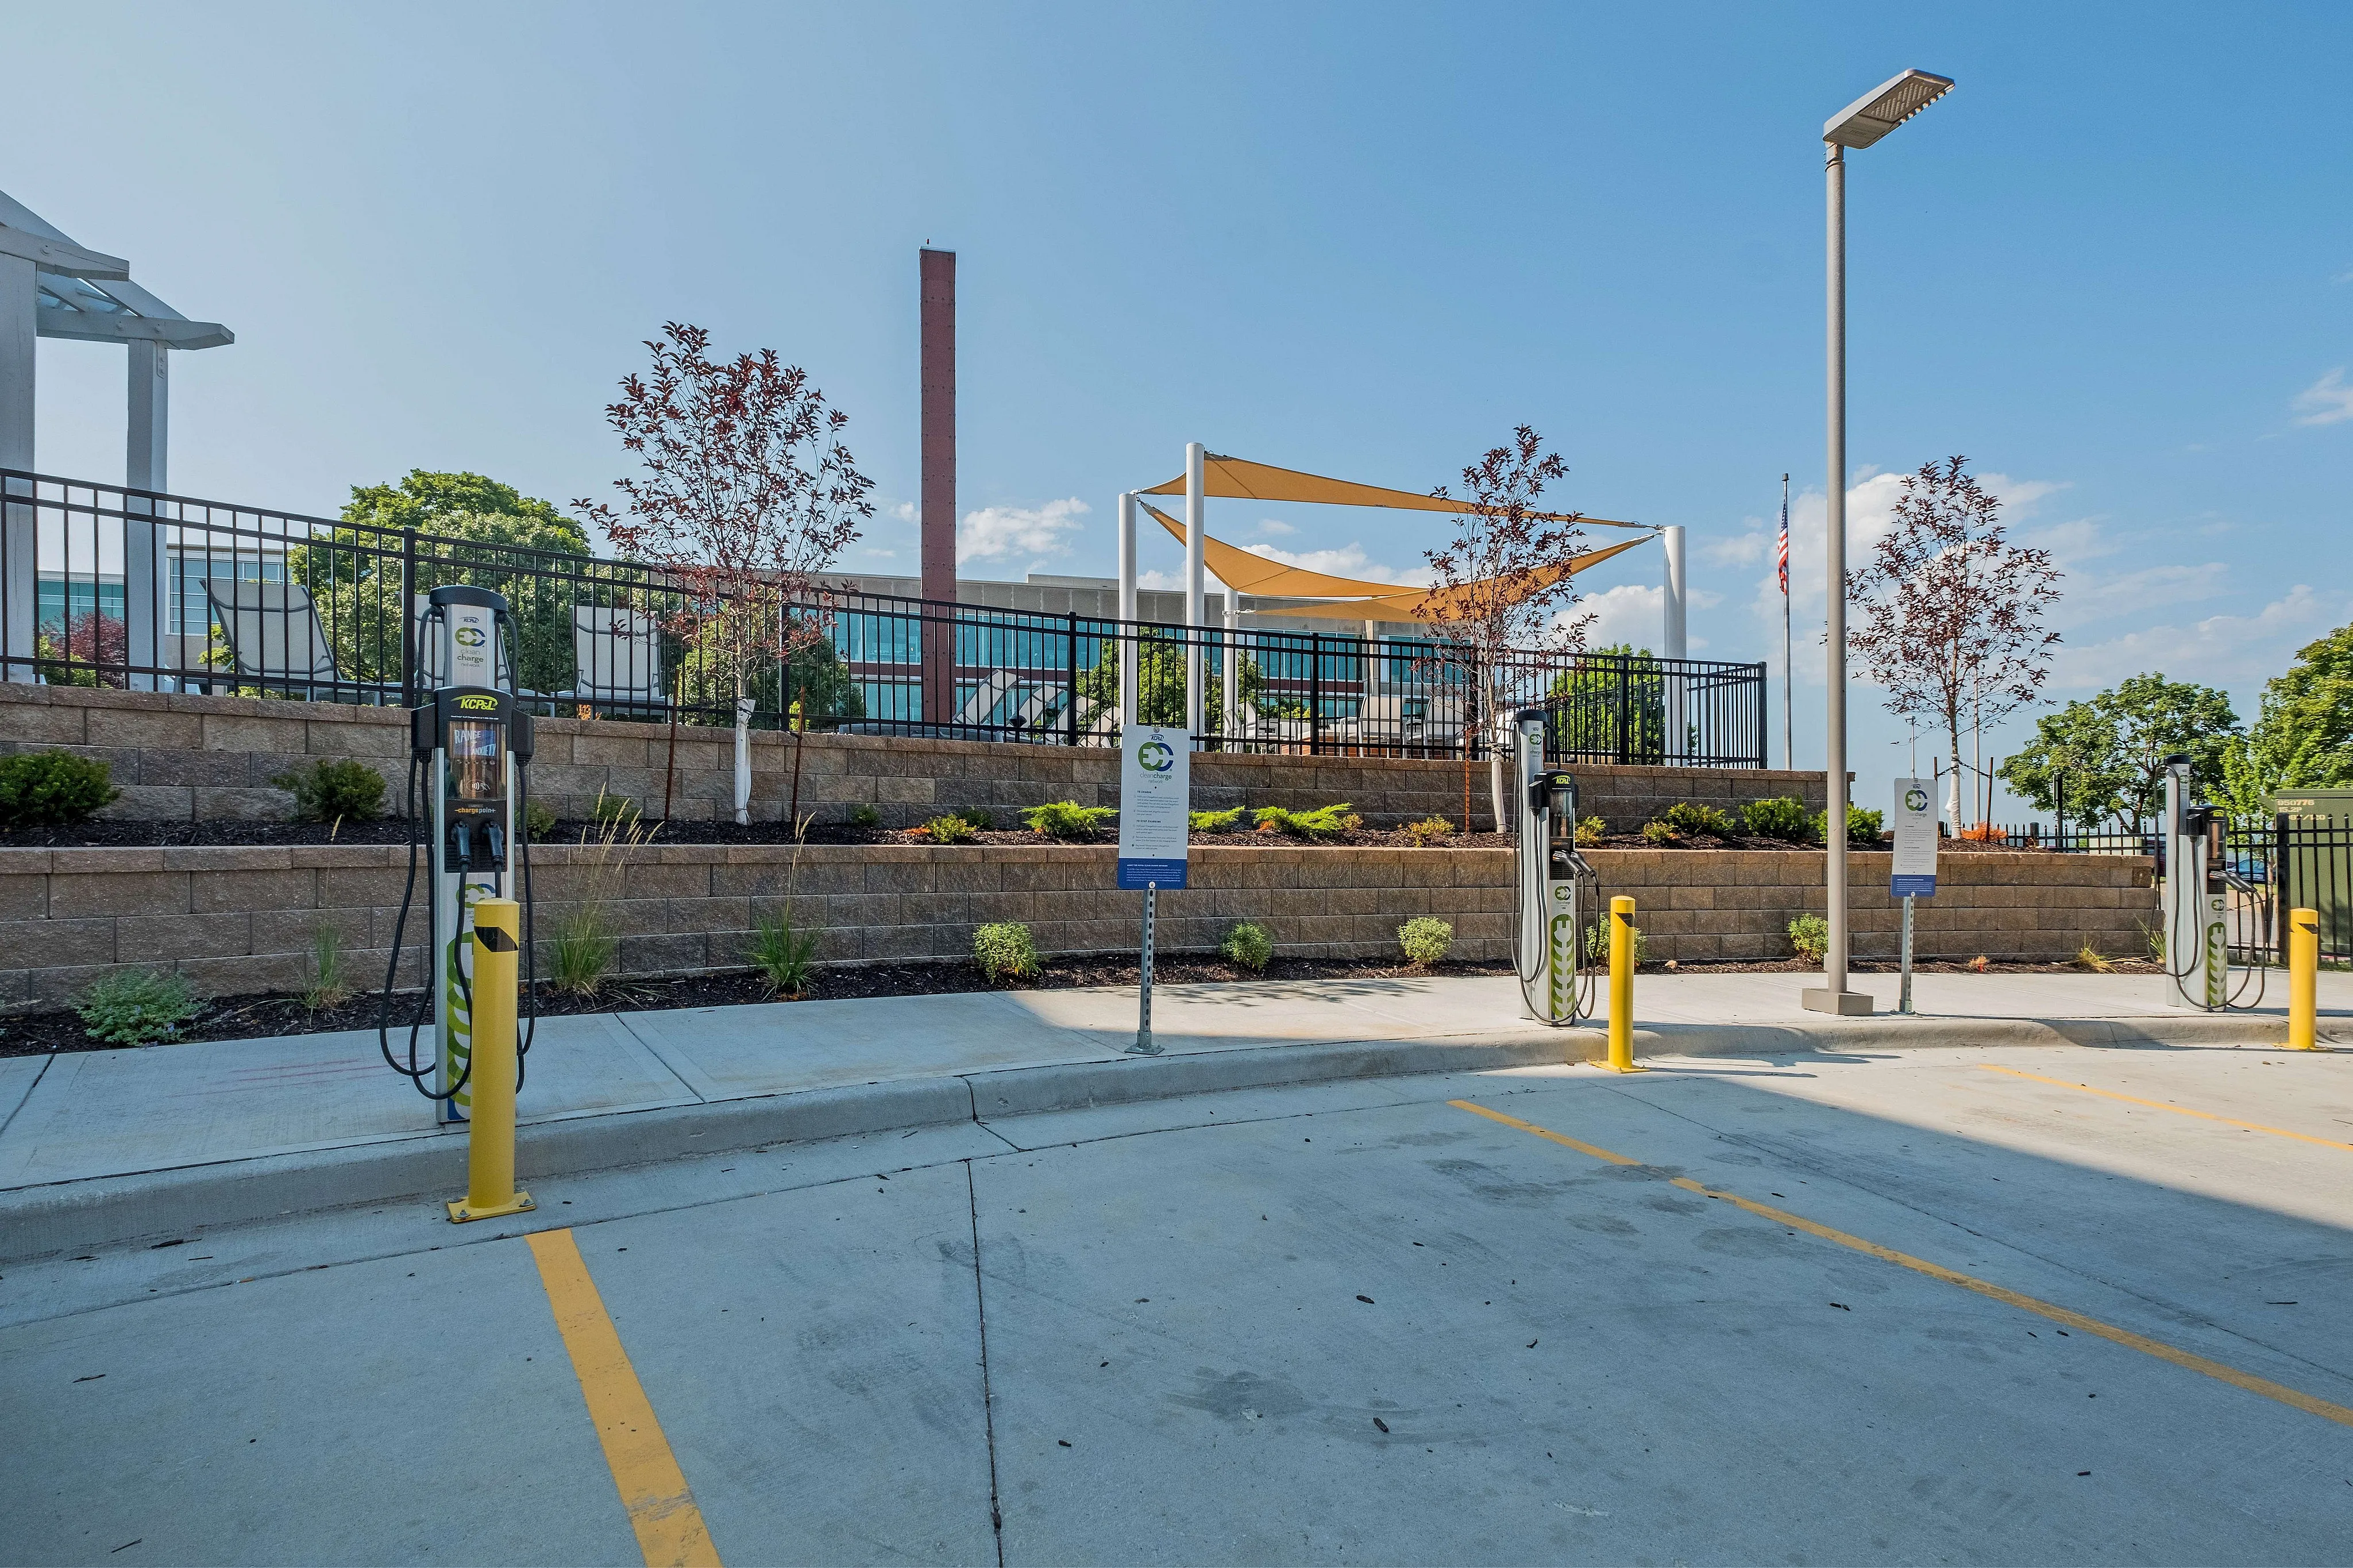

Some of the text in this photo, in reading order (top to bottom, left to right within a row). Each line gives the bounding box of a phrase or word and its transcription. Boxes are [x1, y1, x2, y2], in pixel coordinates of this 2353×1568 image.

[457, 654, 484, 663] charge
[460, 698, 496, 710] KCP&L
[454, 729, 481, 744] RANGE
